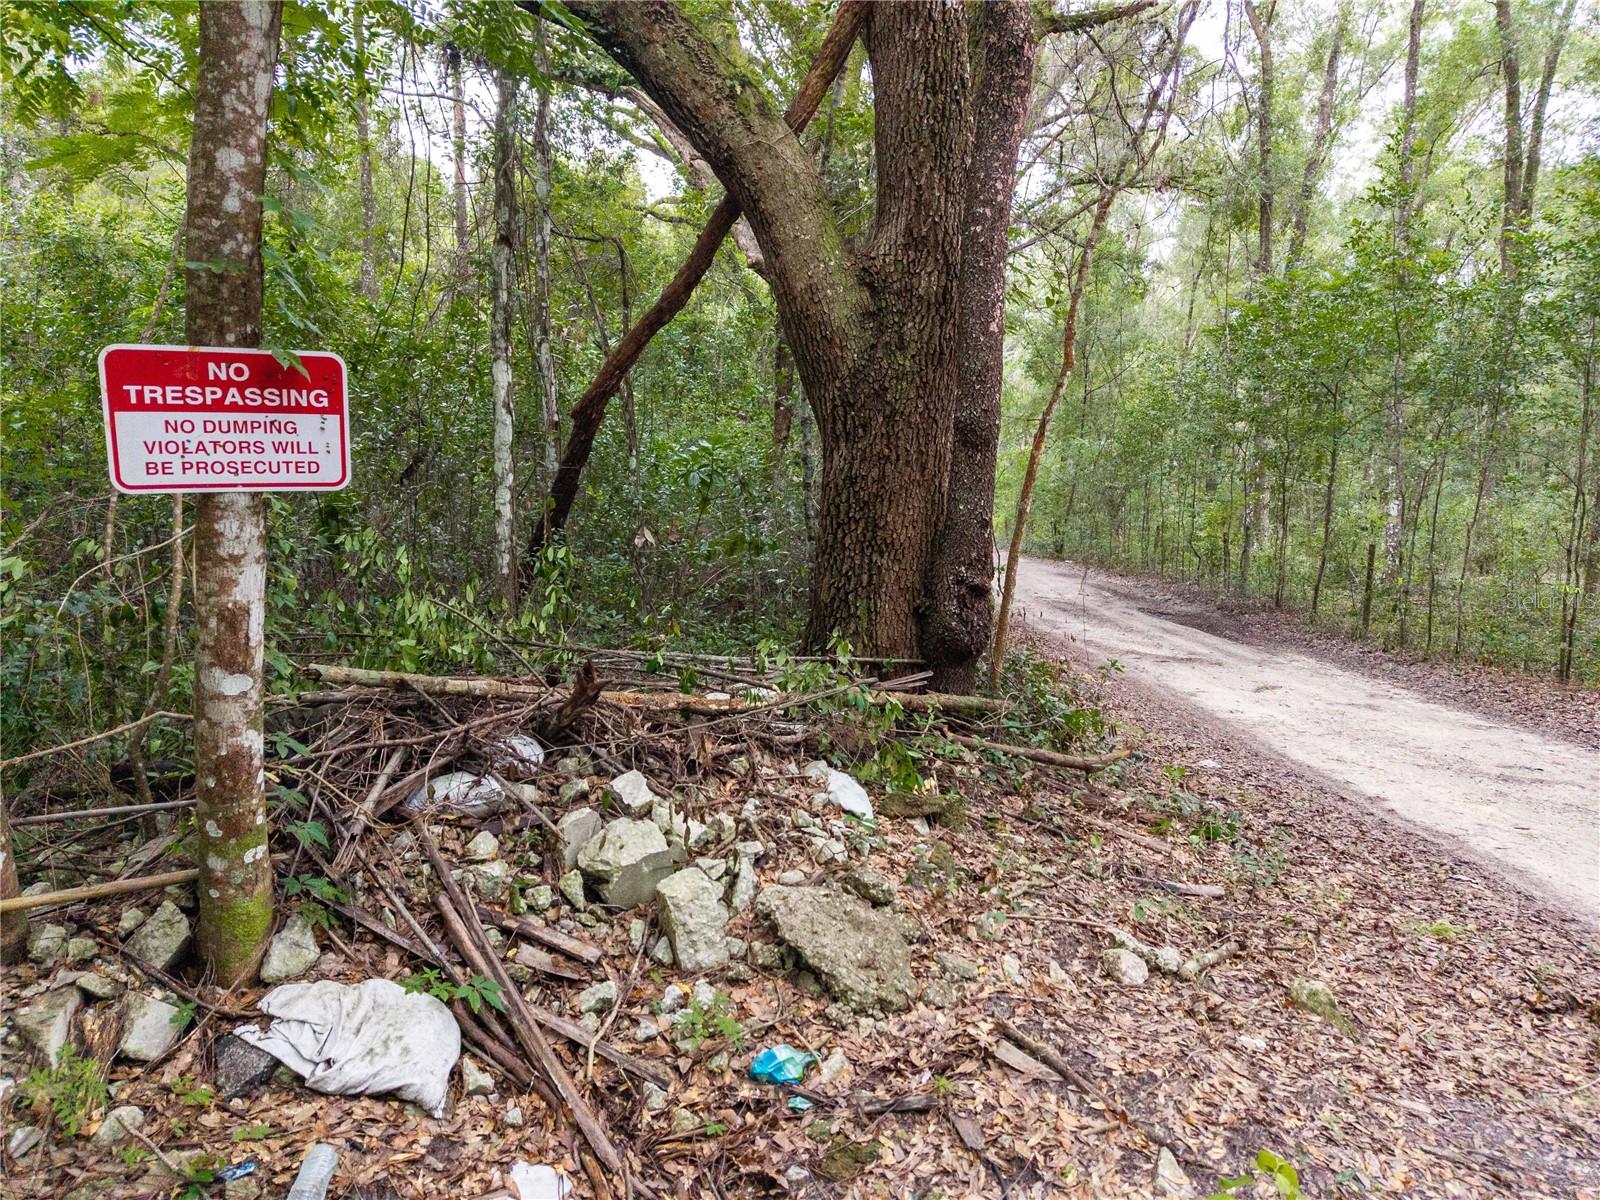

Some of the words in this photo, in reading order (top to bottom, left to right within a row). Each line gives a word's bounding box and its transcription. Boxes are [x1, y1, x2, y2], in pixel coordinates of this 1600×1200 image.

[208, 361, 250, 382] NO
[122, 384, 329, 408] TRESPASSING
[164, 419, 195, 434] NO
[203, 419, 298, 435] DUMPING
[143, 440, 265, 455] VIOLATORS
[271, 440, 319, 455] WILL
[145, 461, 174, 476] BE
[182, 460, 320, 475] PROSECUTED
